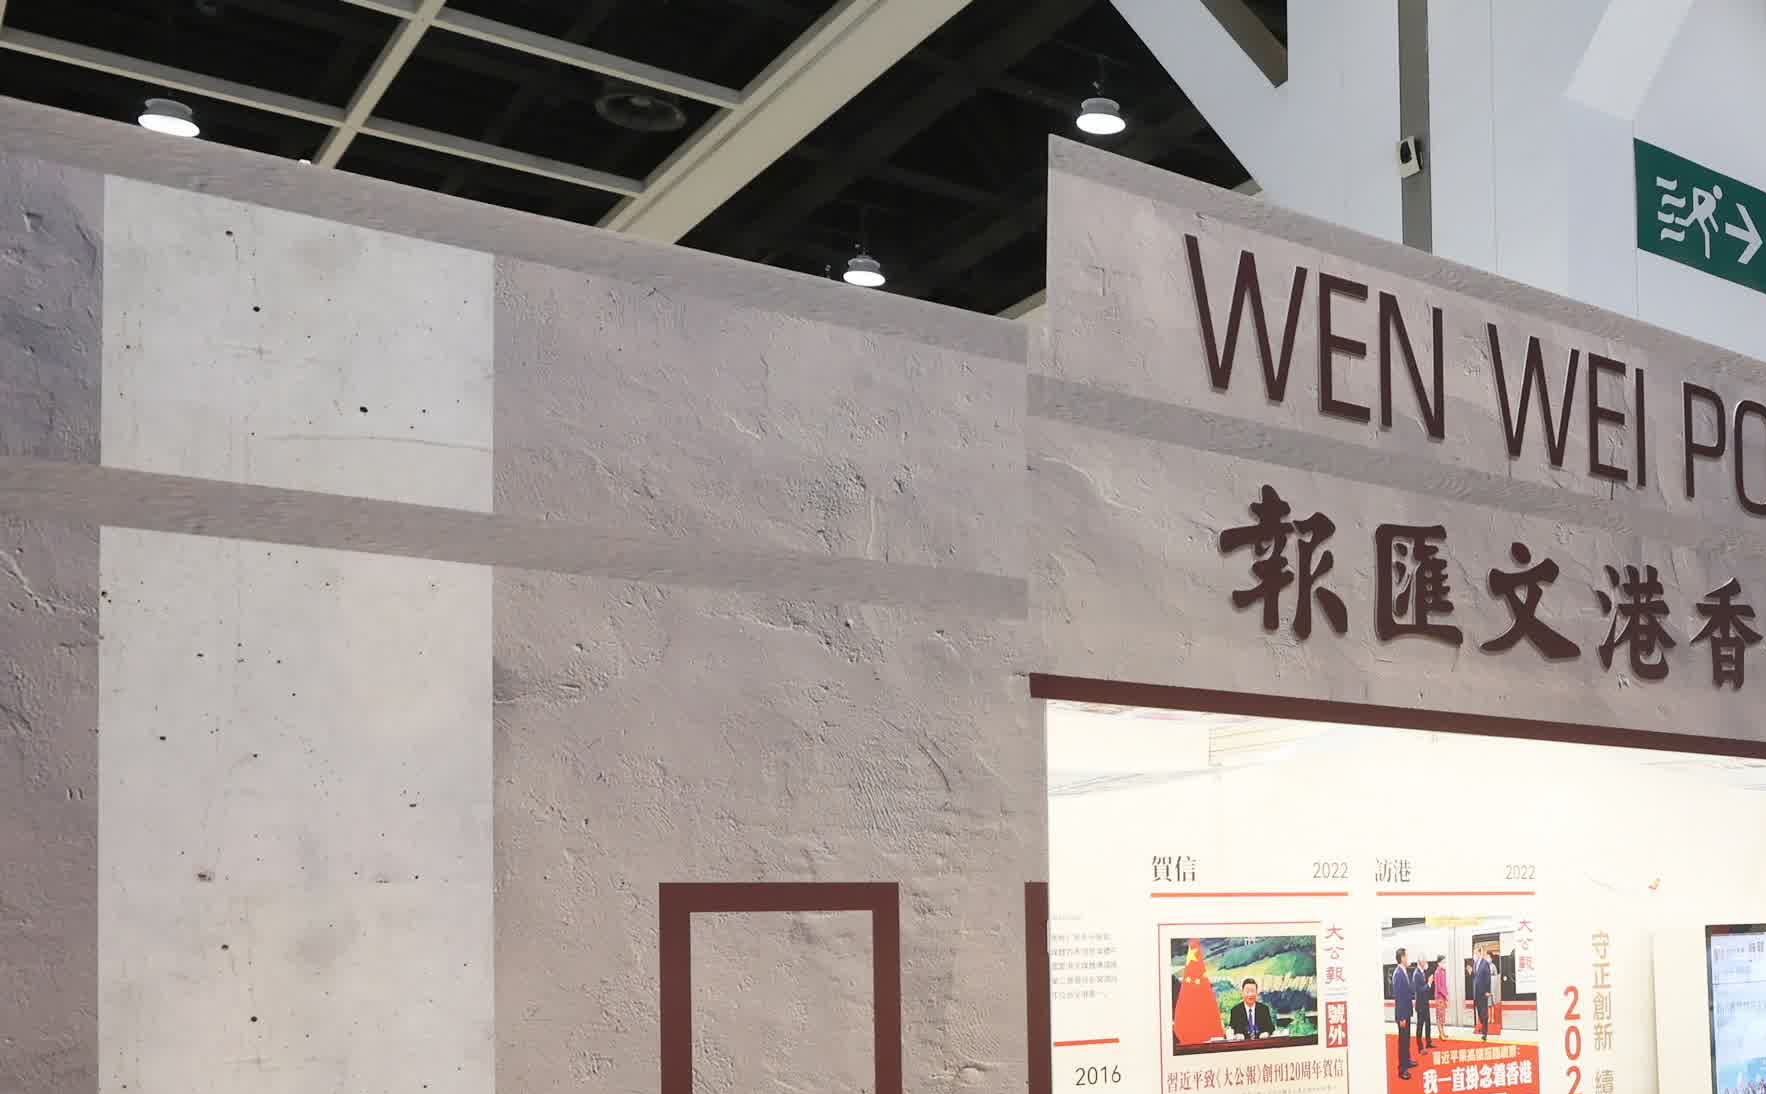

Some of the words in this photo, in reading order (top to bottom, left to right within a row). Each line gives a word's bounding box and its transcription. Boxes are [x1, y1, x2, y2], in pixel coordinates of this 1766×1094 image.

[1184, 233, 1445, 441] WEN
[1487, 322, 1647, 488] WEI
[1151, 854, 1197, 884] 賀信
[1312, 861, 1349, 881] 2022
[1374, 857, 1413, 884] 訪港
[1504, 863, 1536, 881] 2022
[1324, 922, 1347, 985] 大公報
[1591, 930, 1613, 1052] 守正創新
[1326, 1002, 1347, 1047] 號外
[1075, 1064, 1122, 1087] 2016
